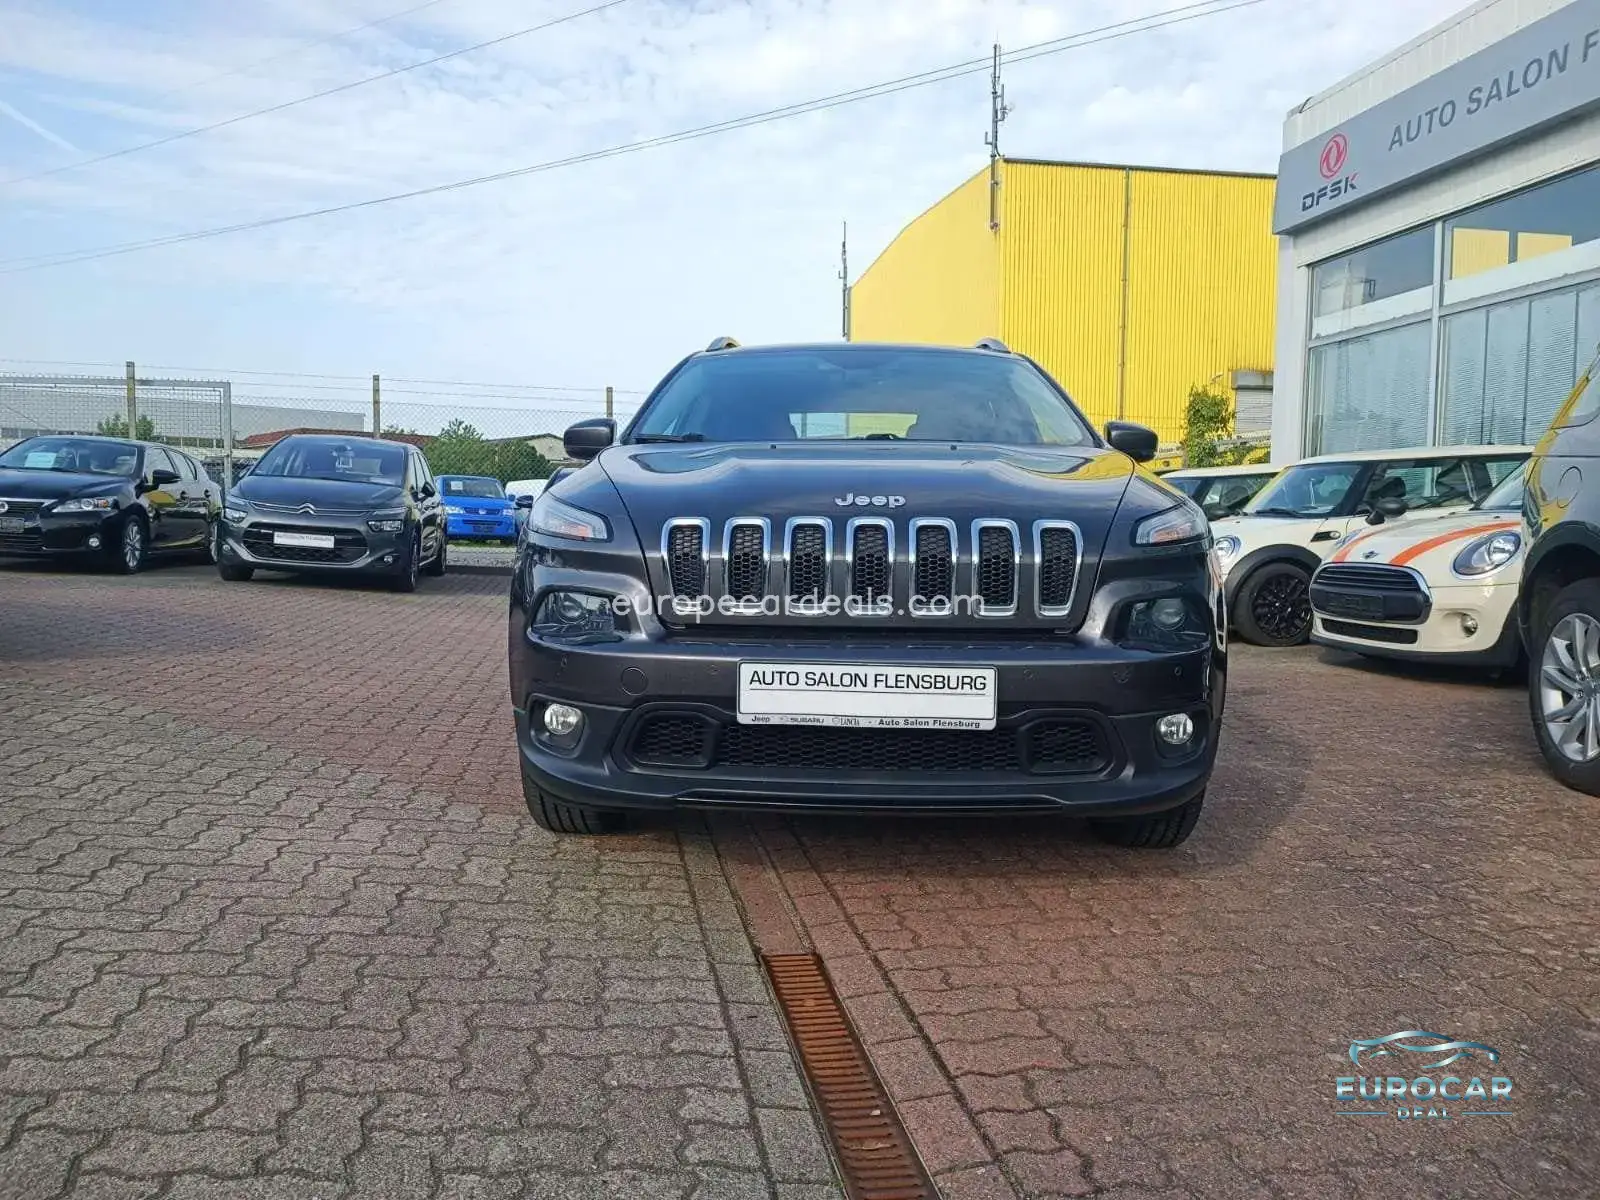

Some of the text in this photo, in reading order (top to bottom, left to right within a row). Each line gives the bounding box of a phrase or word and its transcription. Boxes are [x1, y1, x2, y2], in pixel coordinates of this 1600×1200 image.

[1388, 99, 1456, 151] AUTO
[1466, 42, 1570, 116] SALON
[1301, 172, 1360, 212] DFSK
[834, 492, 906, 508] Jeep
[749, 670, 987, 691] AUTO SALON FLENSBURG
[879, 719, 981, 729] Auto Salon Flensburg
